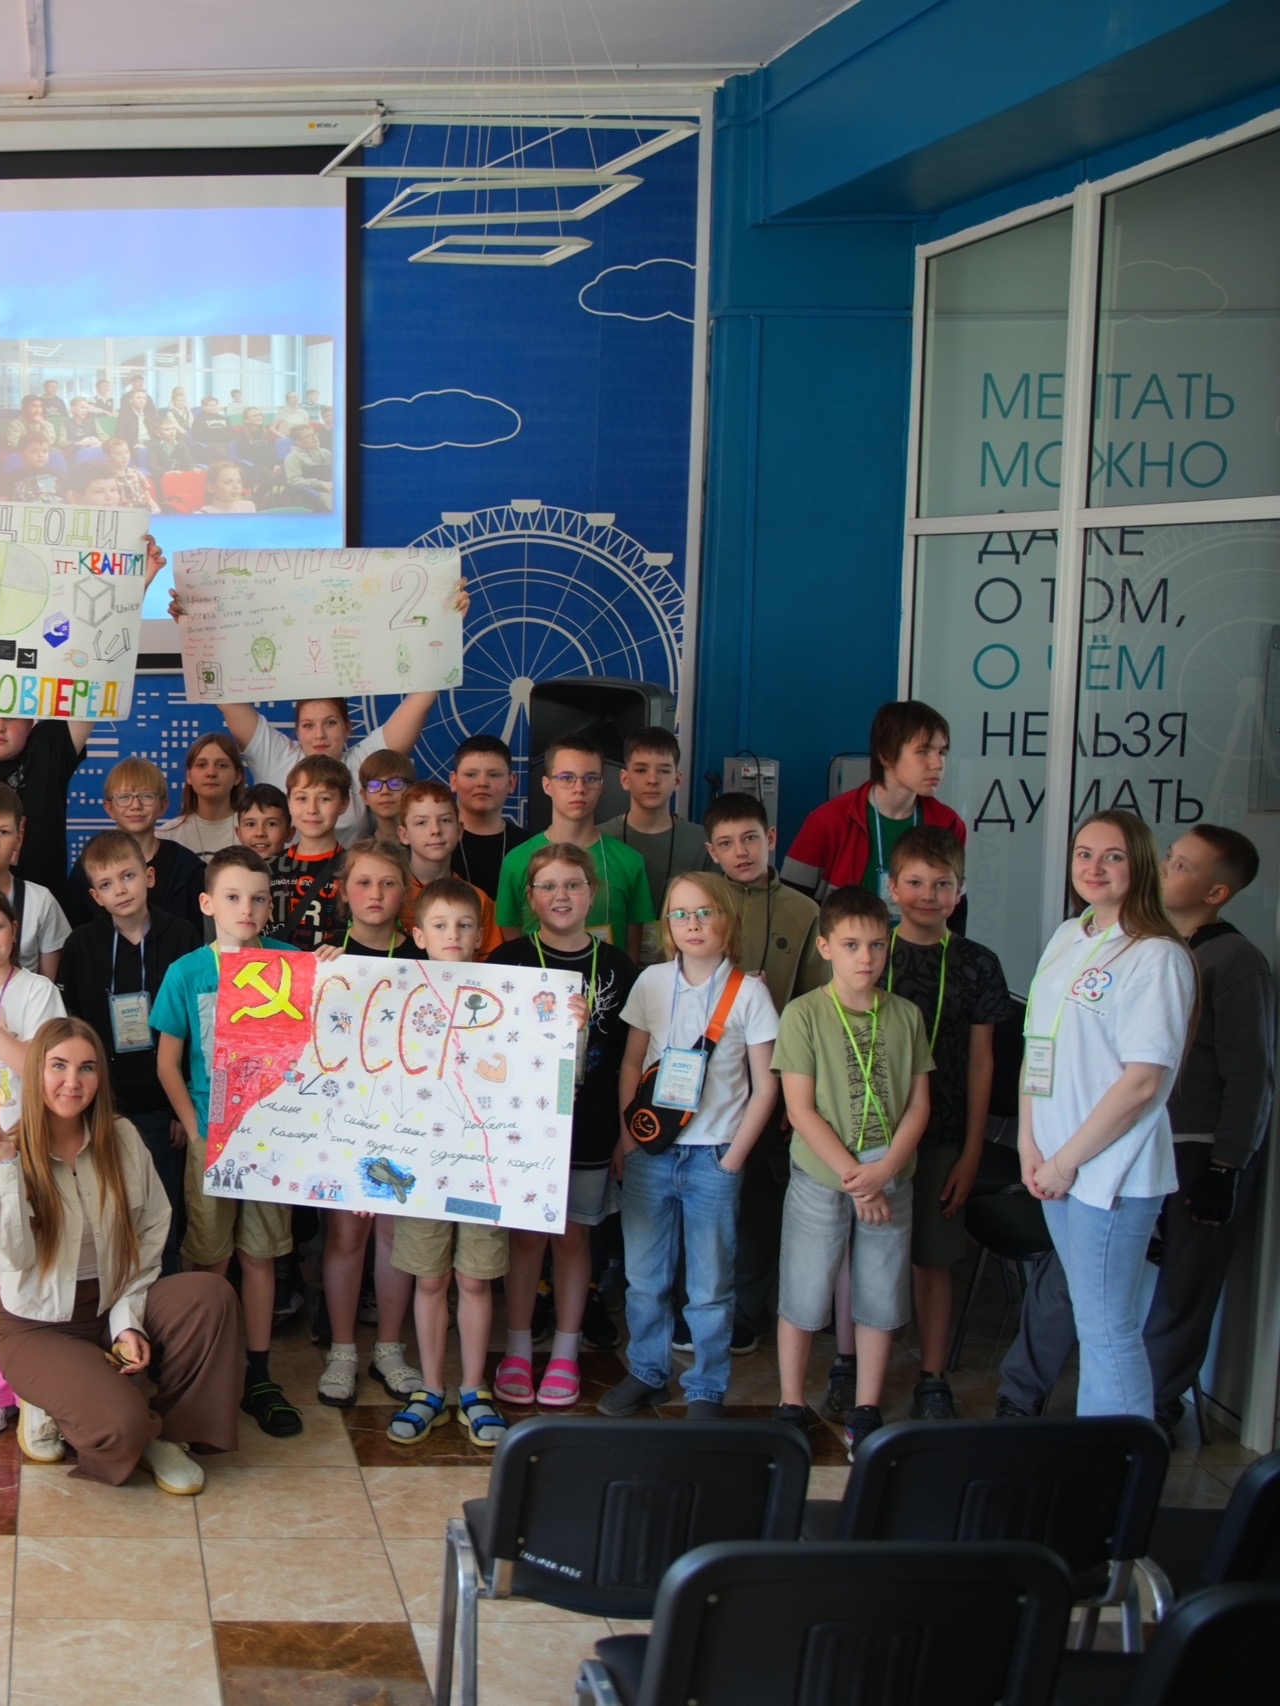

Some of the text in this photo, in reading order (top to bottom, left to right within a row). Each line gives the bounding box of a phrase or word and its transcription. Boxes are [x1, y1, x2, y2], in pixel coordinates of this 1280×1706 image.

[981, 372, 1236, 421] МЕТАТЬ
[115, 602, 140, 614] Unity
[388, 563, 429, 631] 2
[974, 576, 1022, 624] О
[973, 635, 1166, 691] О ЁМ
[312, 975, 505, 1081] СССР
